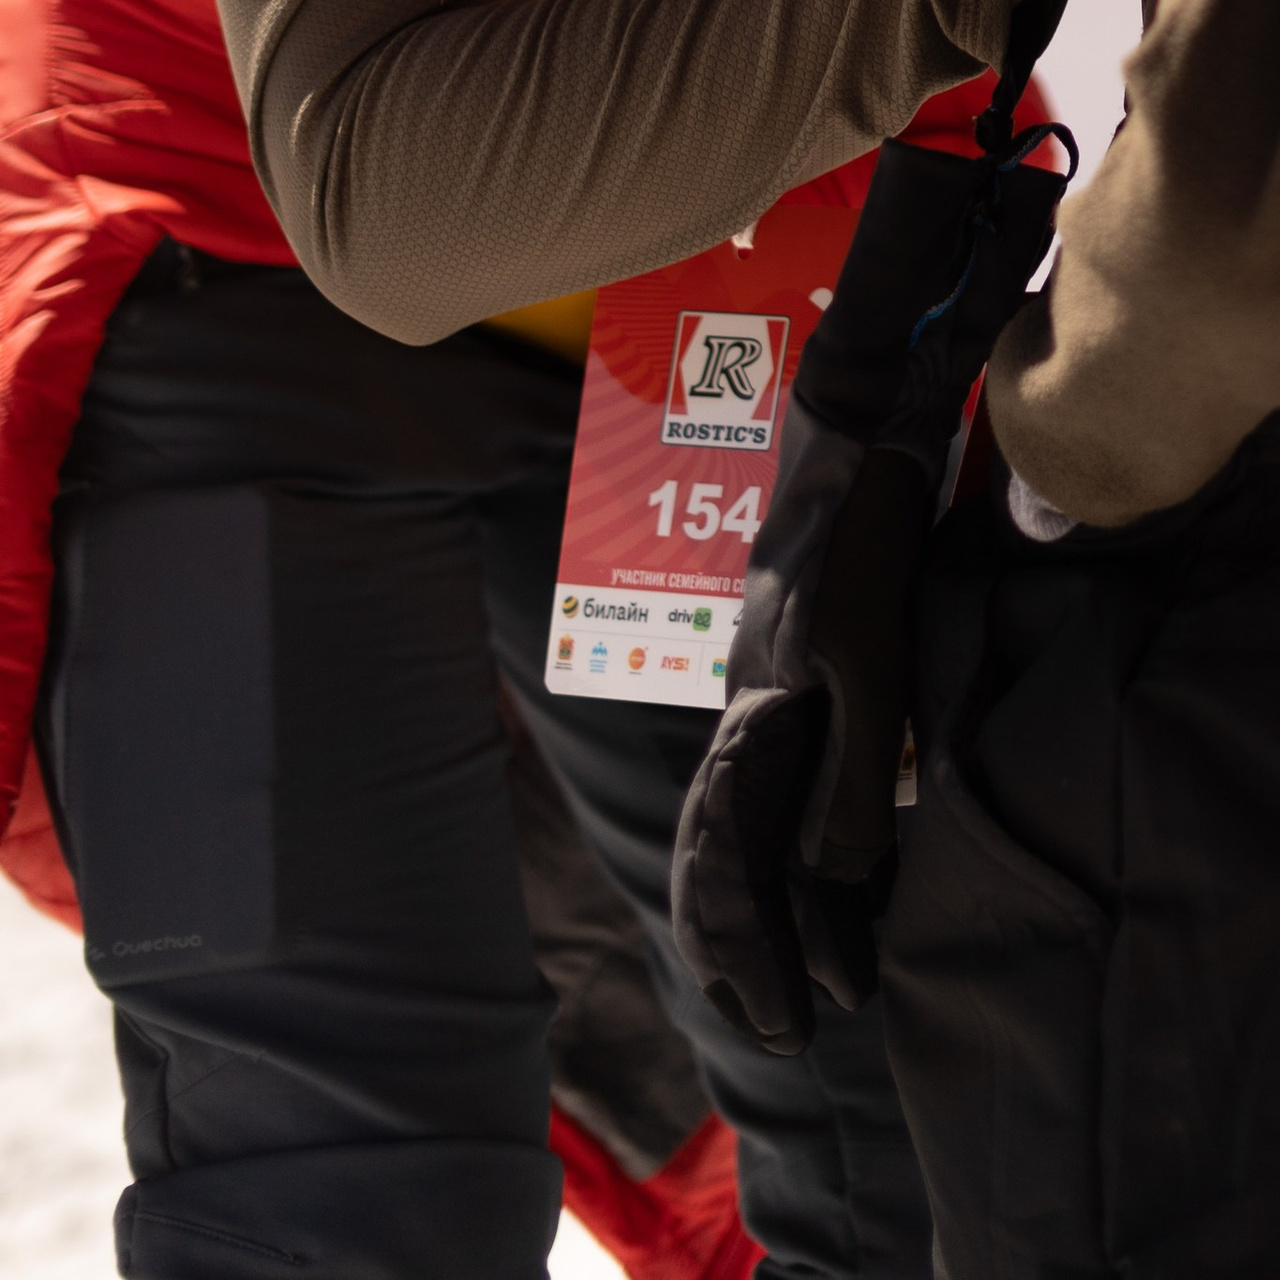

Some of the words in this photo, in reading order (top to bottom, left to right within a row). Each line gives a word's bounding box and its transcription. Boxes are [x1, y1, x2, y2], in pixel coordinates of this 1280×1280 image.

[689, 335, 763, 400] R
[667, 422, 767, 444] ROSTIC'S
[647, 479, 763, 544] 154
[611, 568, 666, 588] УЧАСТНИК
[668, 572, 730, 593] СЕМЕЙНОГО
[583, 597, 649, 623] билайн
